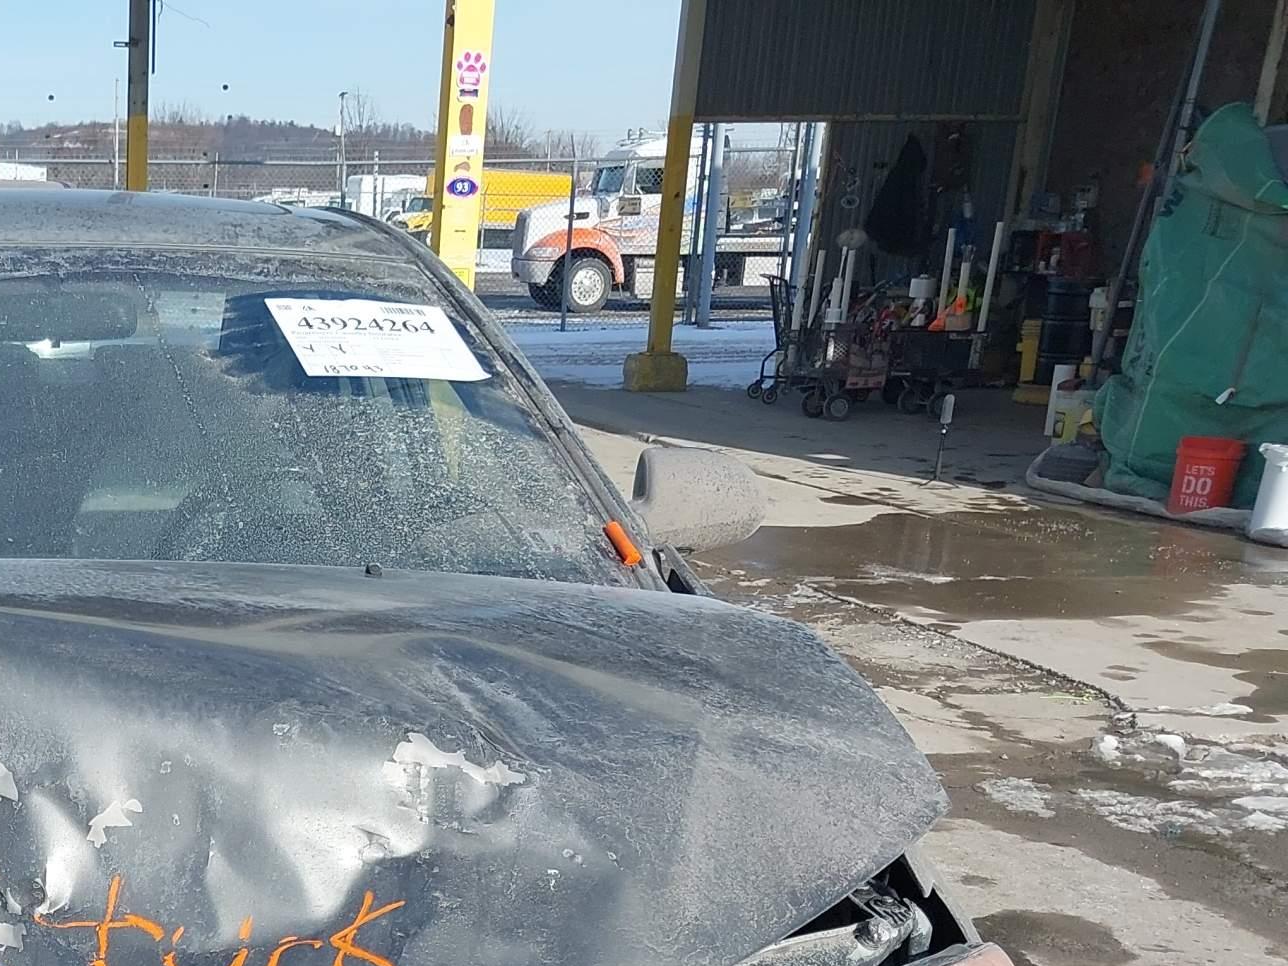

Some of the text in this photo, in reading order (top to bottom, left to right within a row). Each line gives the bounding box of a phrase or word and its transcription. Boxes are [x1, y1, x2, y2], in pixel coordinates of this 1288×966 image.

[455, 181, 470, 193] 93
[297, 315, 436, 335] 43924264
[1181, 475, 1213, 495] DO
[1179, 494, 1210, 509] THIS.
